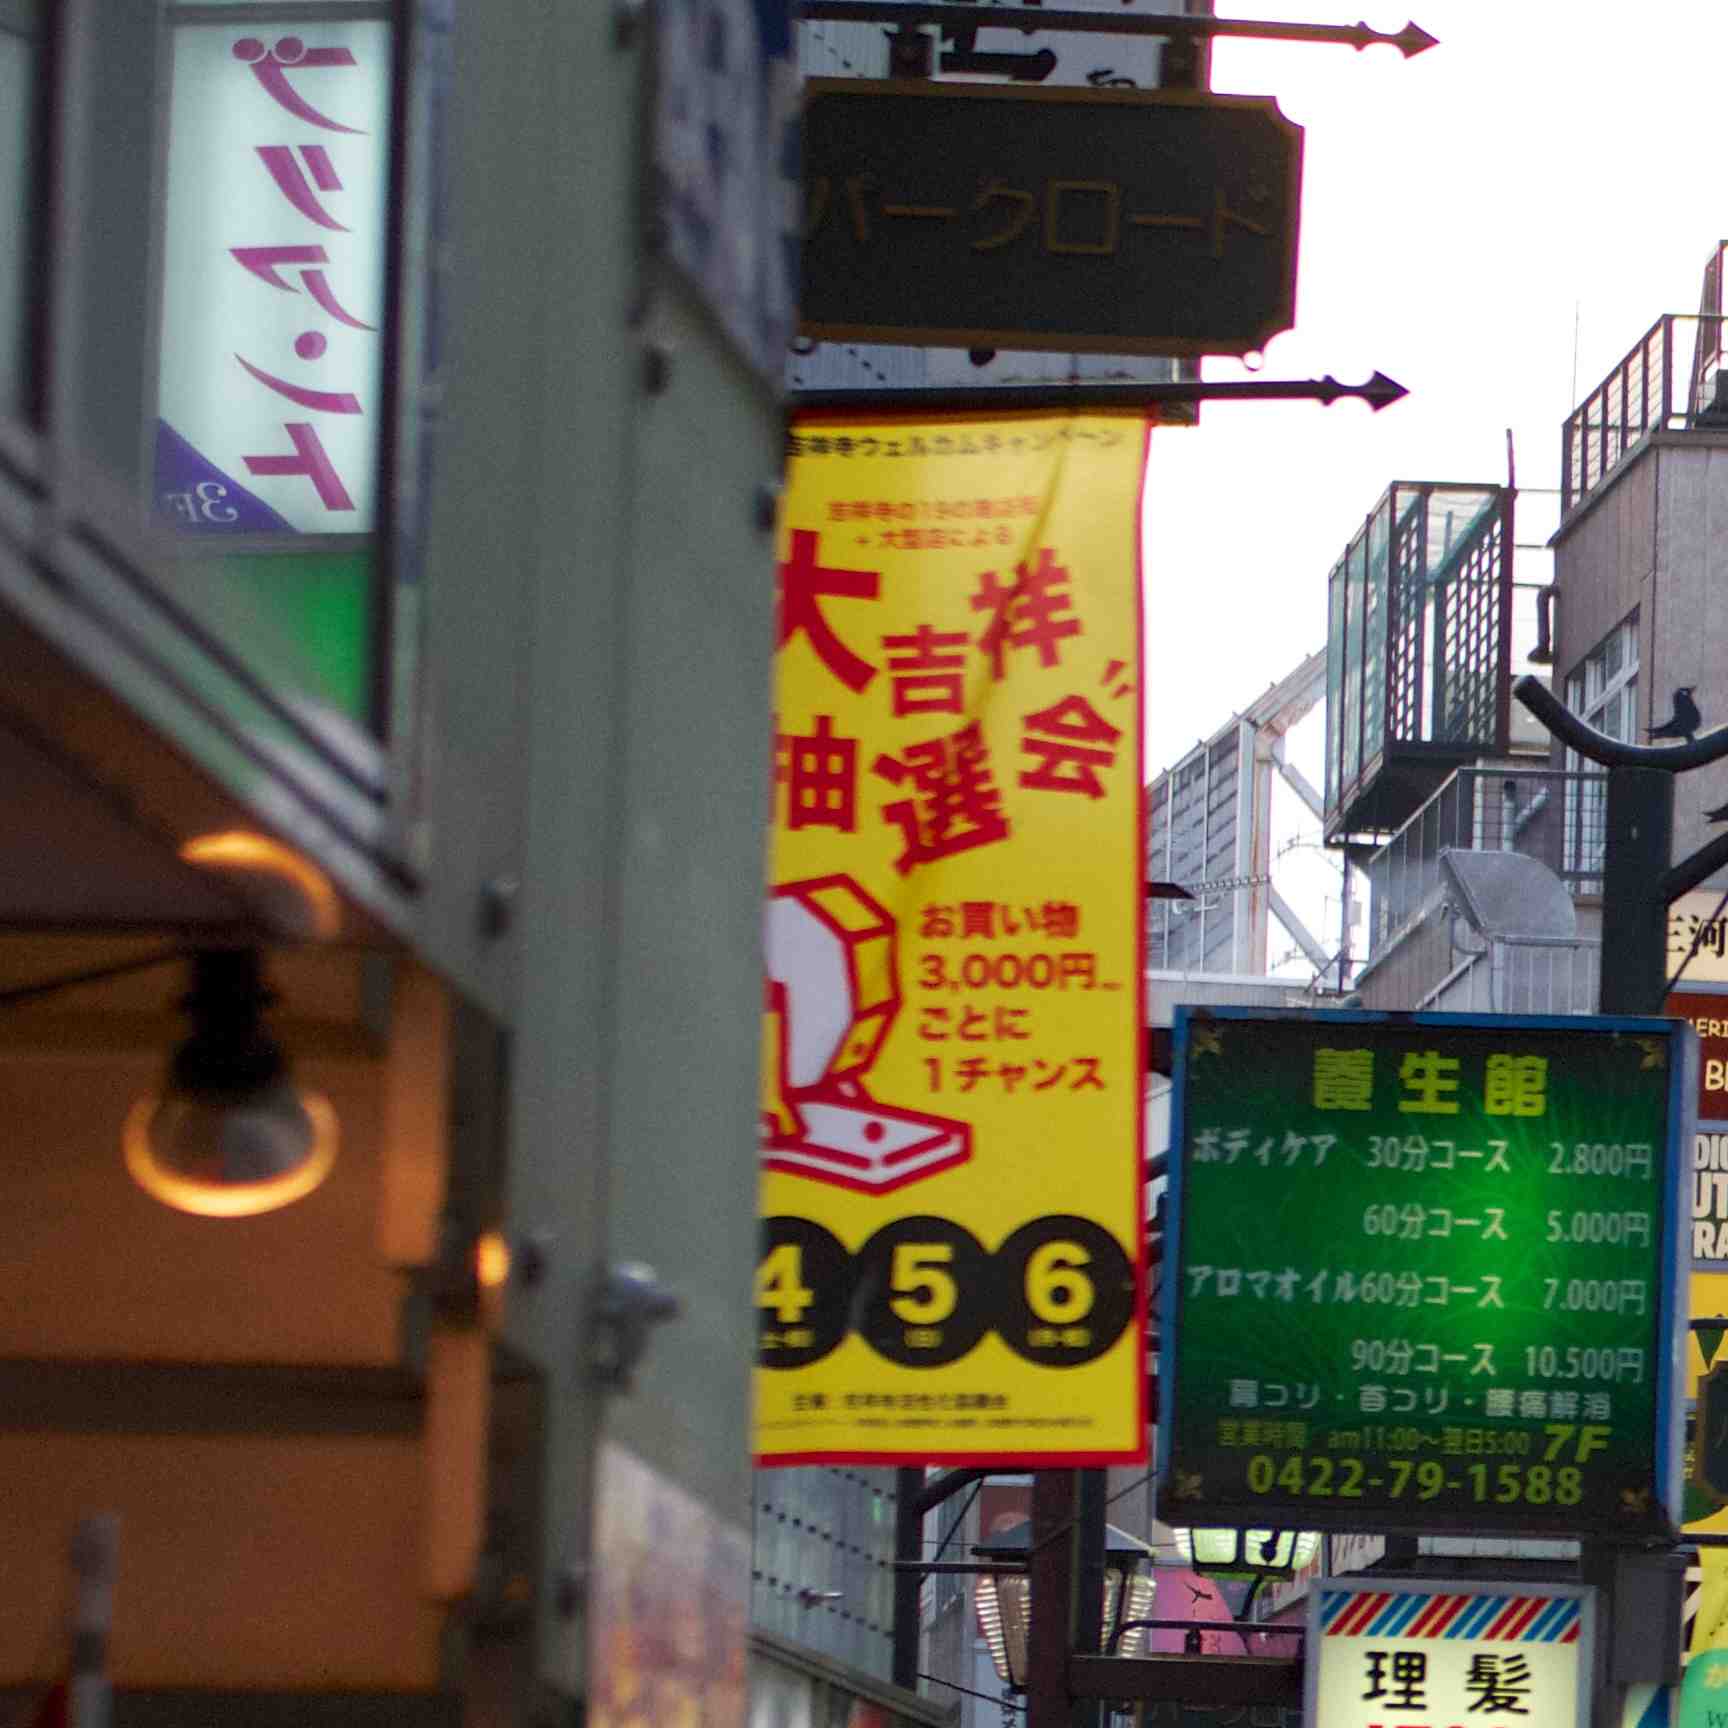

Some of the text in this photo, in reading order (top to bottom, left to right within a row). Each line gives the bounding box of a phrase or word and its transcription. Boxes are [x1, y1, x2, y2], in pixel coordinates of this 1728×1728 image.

[919, 901, 1079, 939] お買い物
[919, 953, 1098, 993] 3,000円
[918, 1006, 1032, 1042] ごとに
[924, 1056, 1105, 1092] 1チャンス
[1313, 1049, 1548, 1116] 養生館
[1191, 1128, 1337, 1165] ボディケア
[1367, 1135, 1511, 1174] 30分コース
[1362, 1205, 1508, 1241] 60分コース
[888, 1244, 958, 1324] 5
[1024, 1241, 1094, 1324] 6
[1351, 1340, 1496, 1377] 90分コース
[1544, 1424, 1612, 1463] 7F
[1246, 1456, 1584, 1506] 0422-79-1588
[1363, 1650, 1533, 1715] 理髪
